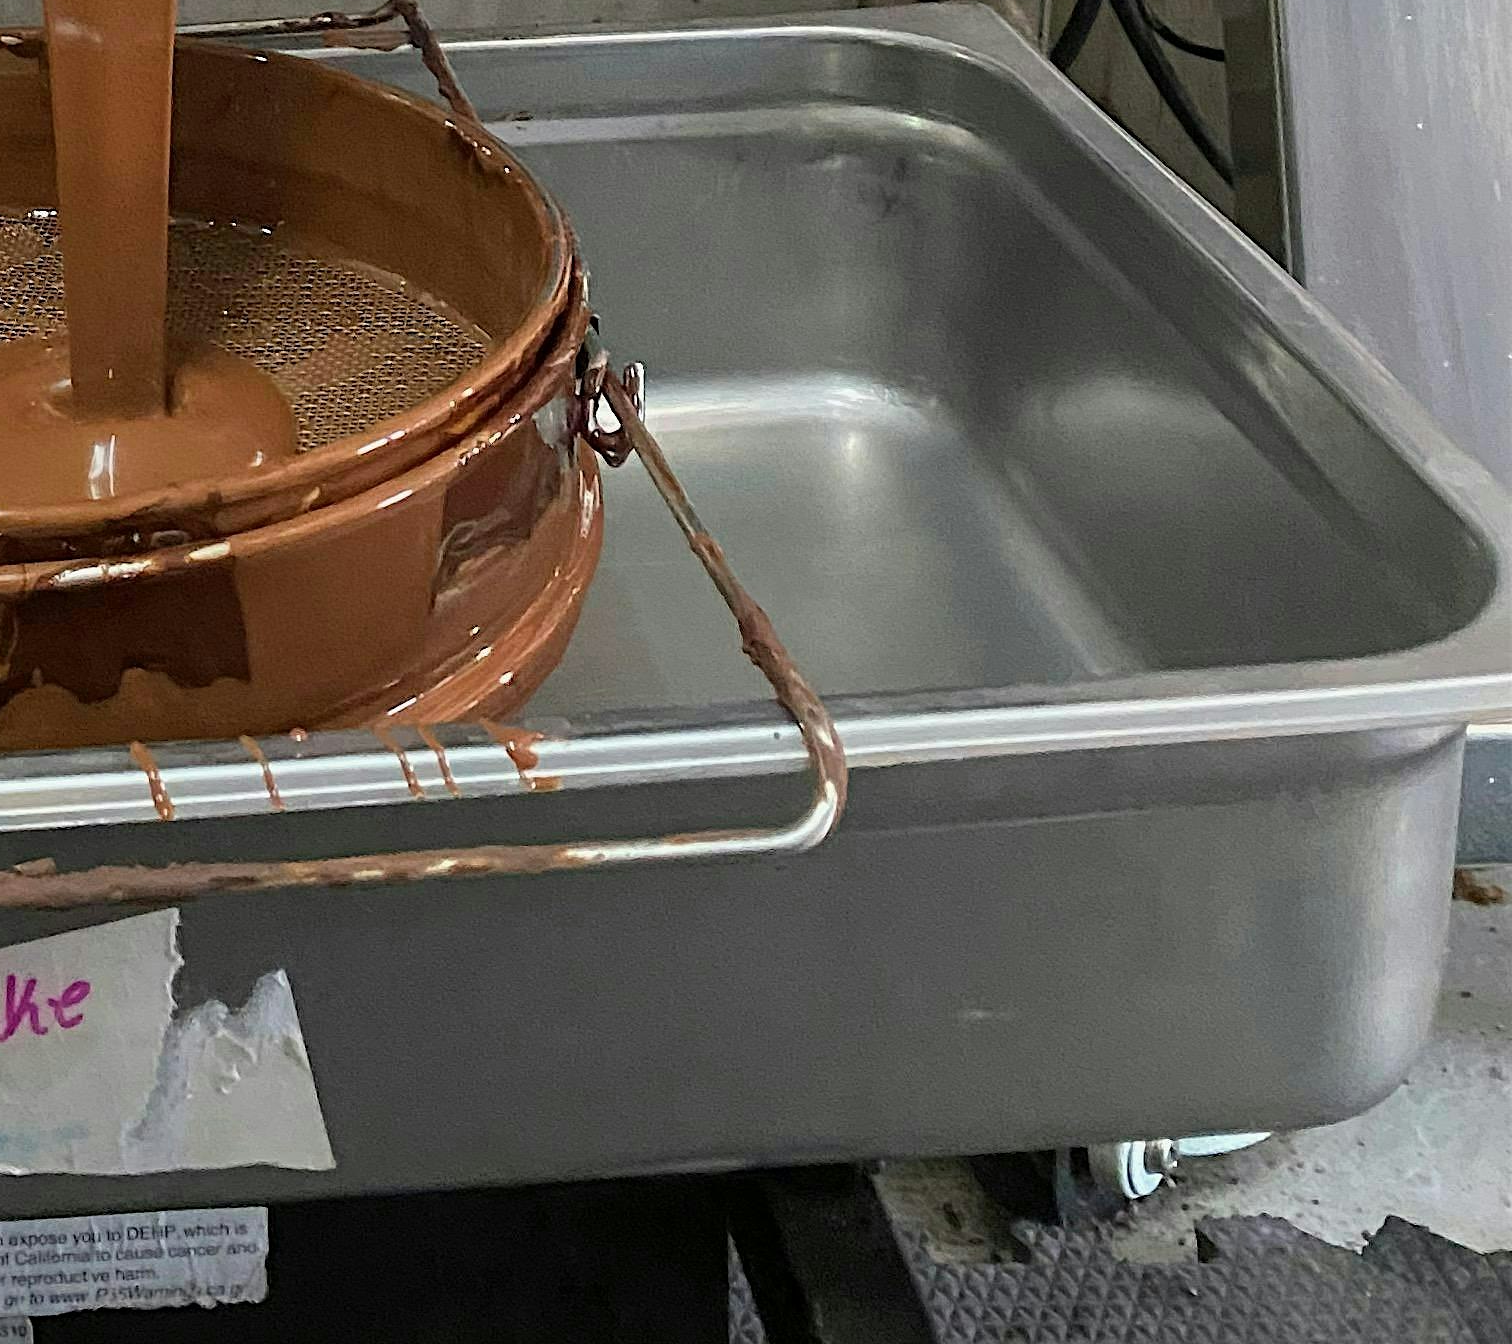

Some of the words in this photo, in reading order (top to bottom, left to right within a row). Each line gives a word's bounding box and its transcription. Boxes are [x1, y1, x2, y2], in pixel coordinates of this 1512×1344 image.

[8, 1231, 67, 1250] expose
[73, 1230, 101, 1245] you
[106, 1229, 122, 1242] to
[184, 1222, 230, 1238] which
[235, 1222, 249, 1235] is
[14, 1248, 90, 1267] California
[95, 1247, 112, 1262] to
[115, 1247, 163, 1261] cause
[167, 1243, 222, 1258] cancer
[226, 1241, 258, 1255] and
[11, 1268, 110, 1290] reproductve
